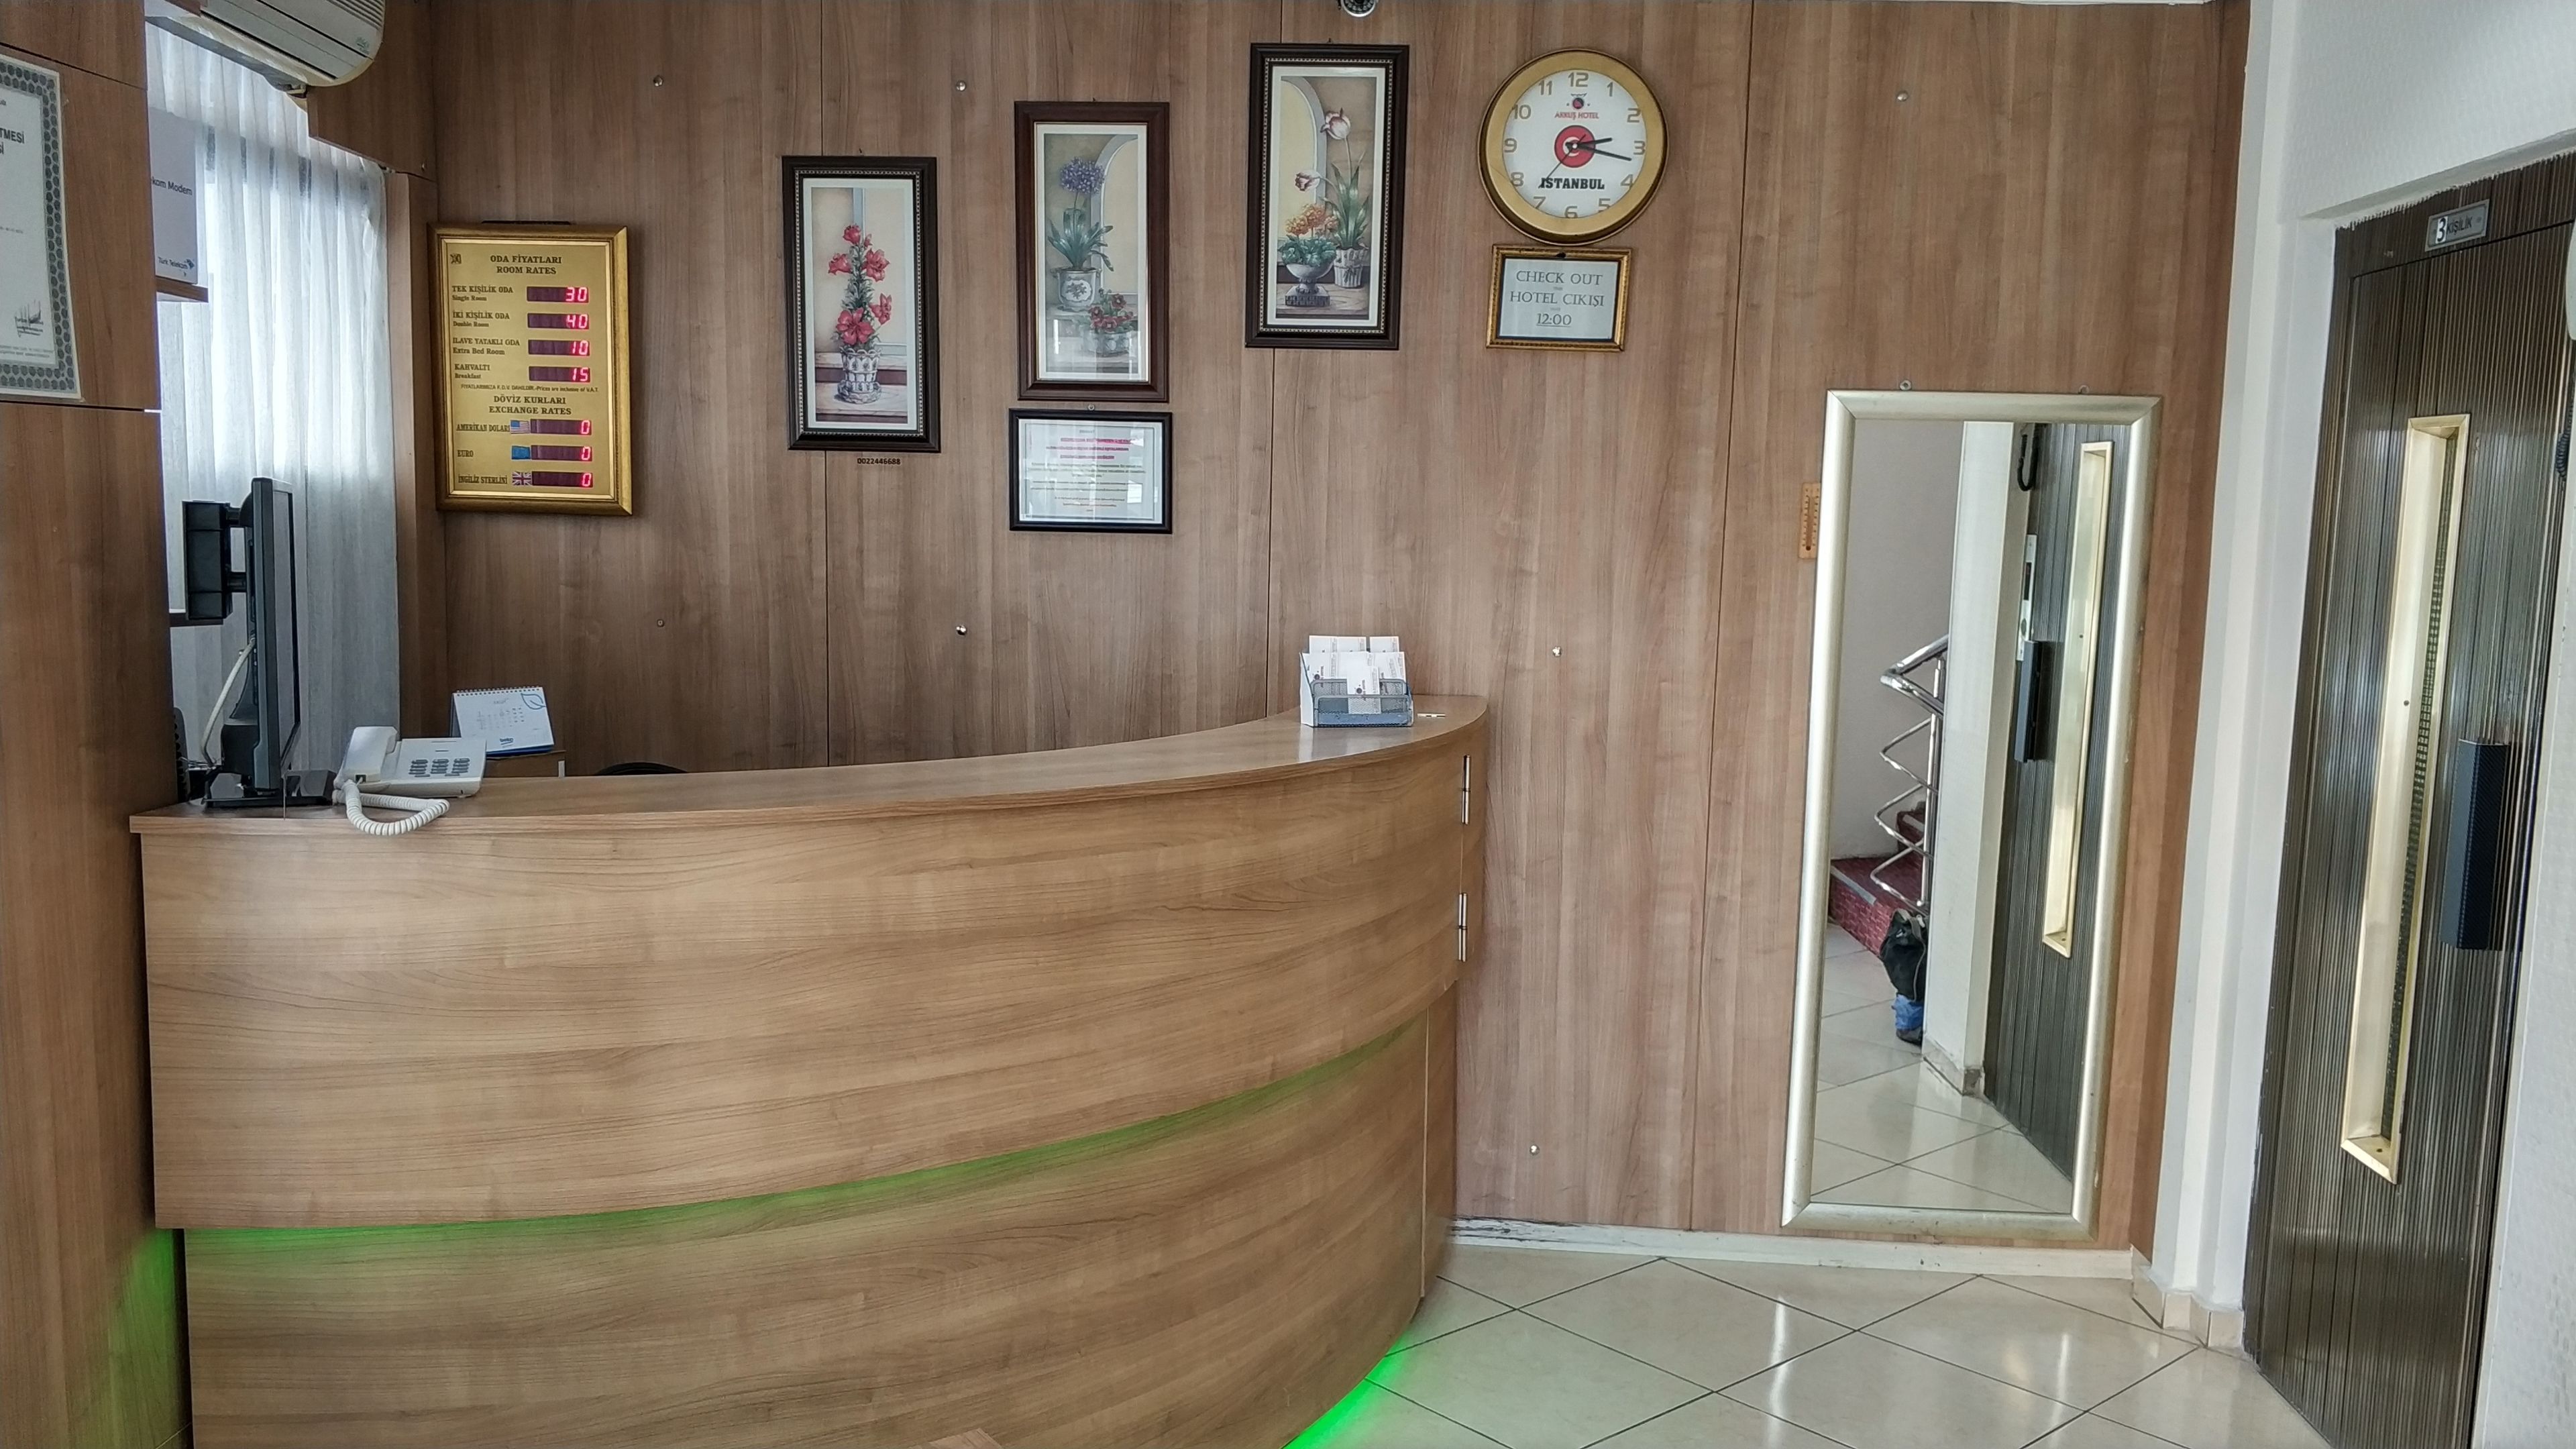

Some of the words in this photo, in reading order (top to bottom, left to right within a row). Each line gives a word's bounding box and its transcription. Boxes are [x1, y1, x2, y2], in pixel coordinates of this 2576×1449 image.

[1568, 72, 1589, 87] 12
[1538, 80, 1553, 95] 11
[1607, 82, 1614, 97] 1
[1513, 105, 1532, 120] 10
[1554, 111, 1576, 120] AKKUŞ
[1578, 111, 1599, 119] HOTEL
[1627, 107, 1641, 123] 2
[1504, 138, 1517, 153] 9
[1633, 140, 1646, 155] 3
[1511, 172, 1524, 186] 8
[1620, 174, 1633, 188] 4
[168, 180, 193, 195] Modem
[1533, 197, 1546, 209] 7
[1598, 198, 1611, 213] 5
[2436, 217, 2446, 242] 3
[2447, 215, 2473, 235] KİŞİLİK
[512, 254, 562, 264] FİYATLARI
[496, 266, 523, 274] ROOM
[526, 266, 557, 275] RATES
[1516, 270, 1564, 284] CHECK
[1570, 273, 1603, 286] OUT
[566, 286, 588, 302] 30
[1509, 290, 1558, 305] HOTEL
[466, 310, 494, 320] KİŞİLİK
[566, 313, 588, 329] 40
[1536, 313, 1572, 325] 12:00
[572, 340, 588, 356] 10
[573, 367, 588, 382] 15
[494, 394, 521, 404] DÖVİZ
[524, 396, 566, 405] KURLARI
[488, 406, 539, 415] EXCHANGE
[541, 407, 572, 415] RATES
[456, 422, 488, 432] AMERİKAN
[581, 419, 590, 435] 0
[582, 445, 591, 461] 0
[582, 472, 592, 488] 0
